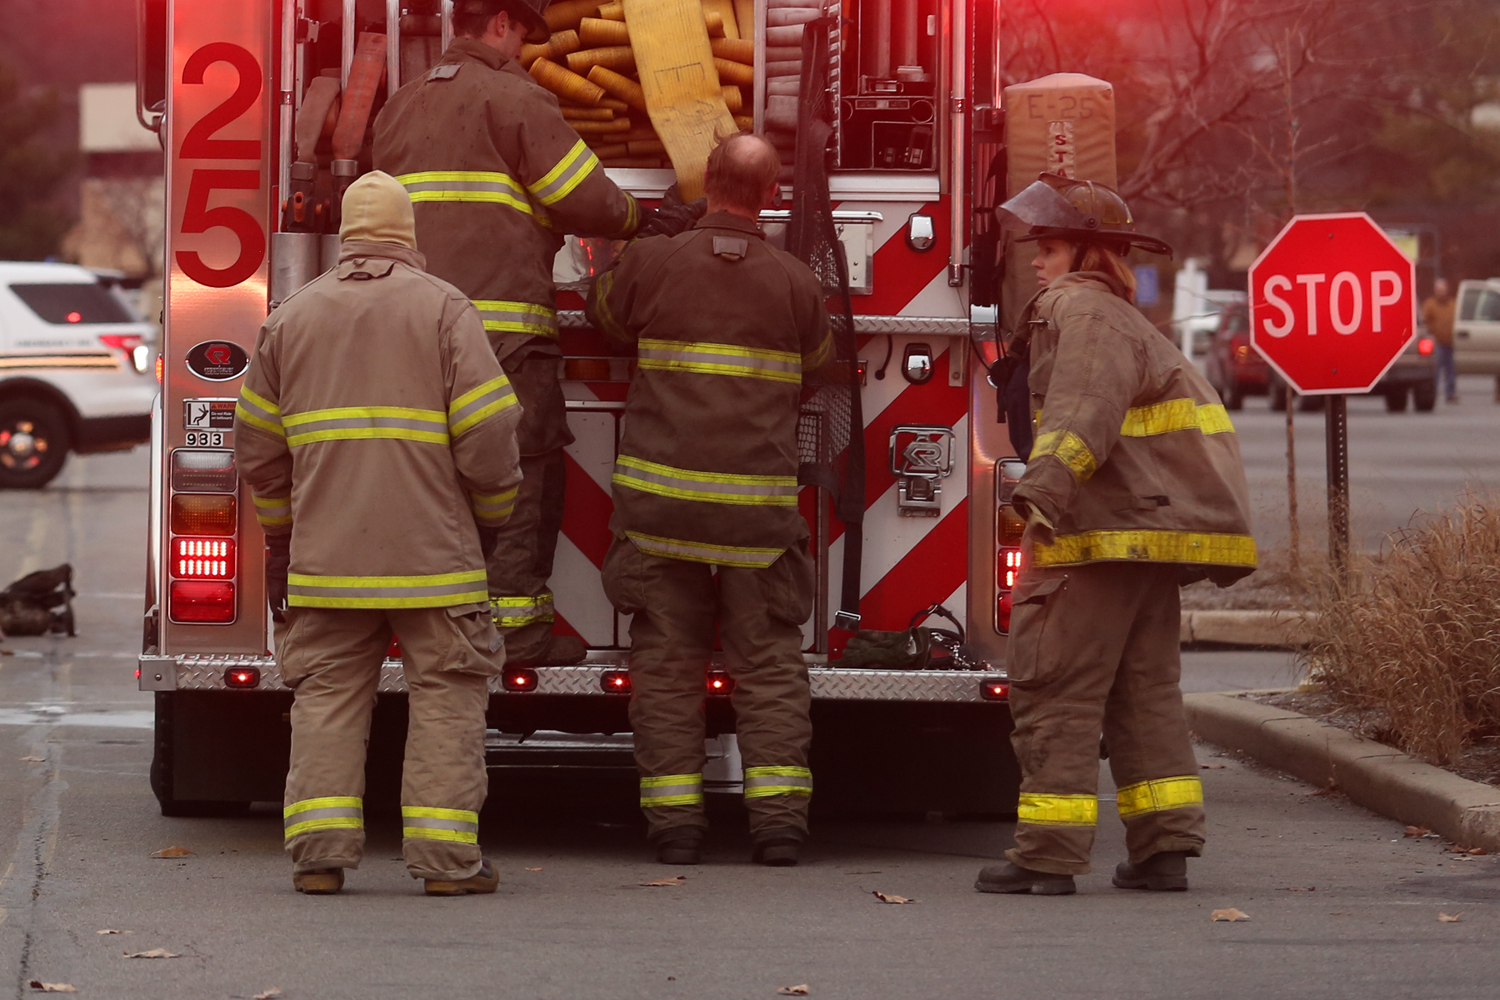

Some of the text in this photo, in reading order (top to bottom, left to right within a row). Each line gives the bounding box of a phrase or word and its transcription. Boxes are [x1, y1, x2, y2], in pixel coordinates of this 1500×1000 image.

[1027, 94, 1095, 119] E-25
[1054, 134, 1068, 178] STA
[1262, 270, 1403, 338] STOP
[187, 433, 222, 446] 983
